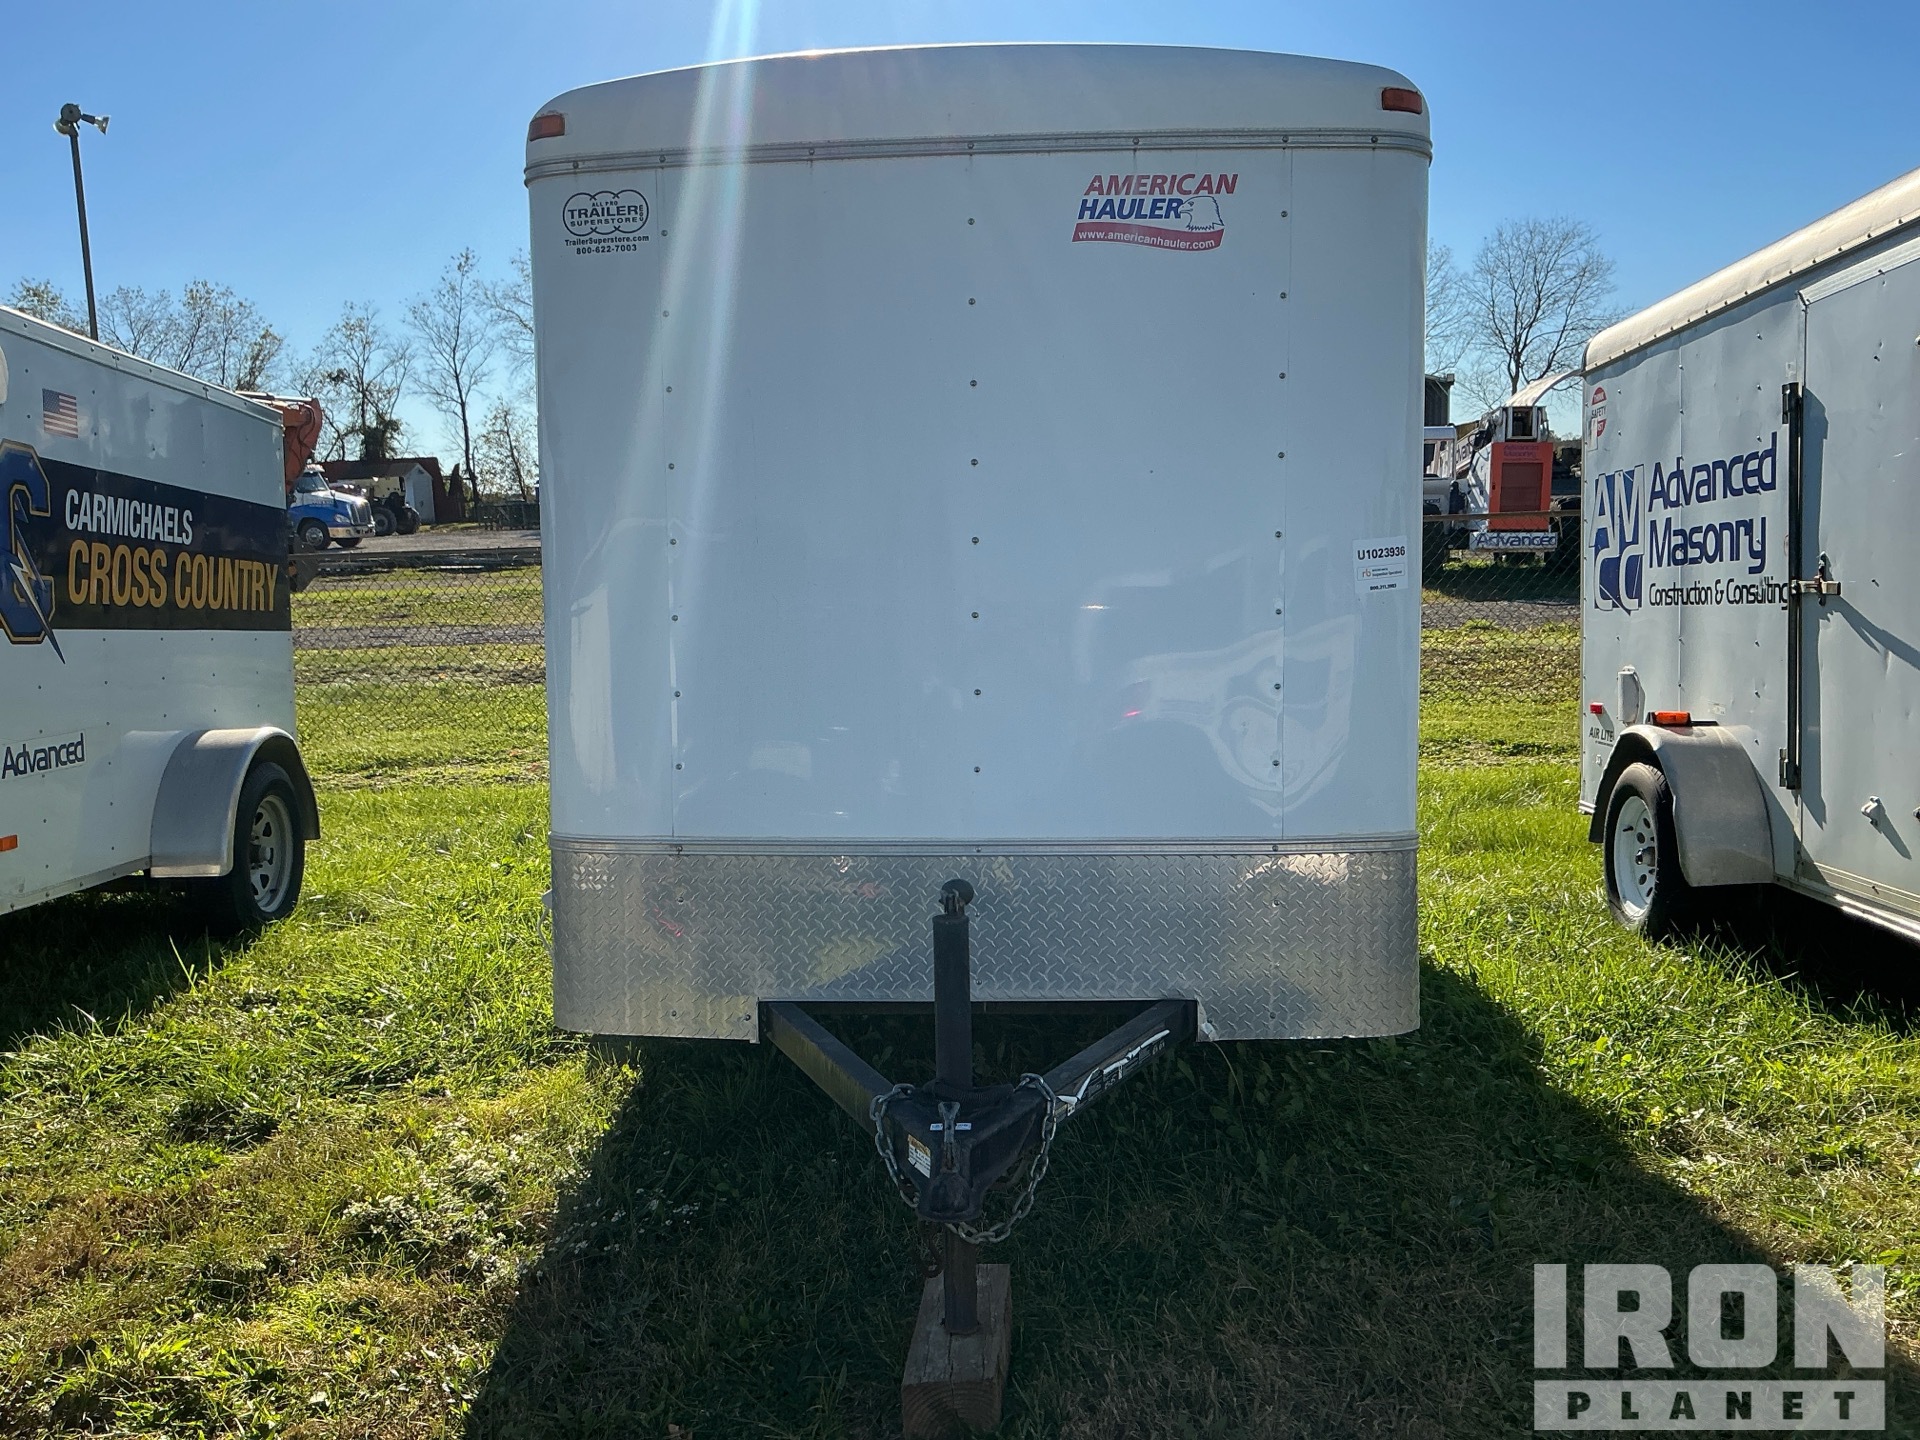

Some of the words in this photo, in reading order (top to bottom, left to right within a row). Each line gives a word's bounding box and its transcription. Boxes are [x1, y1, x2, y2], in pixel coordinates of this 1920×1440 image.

[1083, 173, 1239, 196] AMERICAN
[568, 205, 638, 219] TRAILER
[1077, 198, 1184, 220] HAULER
[570, 216, 638, 227] SUPERSTORE
[564, 235, 650, 247] TrailerSuperstore.com
[576, 244, 637, 255] 800-622-7003
[1078, 230, 1216, 250] www.americanhauler.com
[1648, 431, 1777, 513] Advanced
[65, 488, 193, 546] CARMICHAELS
[1476, 533, 1557, 548] Advanced
[1649, 516, 1767, 575] Masonry
[1357, 545, 1406, 561] U1023936
[68, 539, 168, 608] CROSS
[174, 551, 279, 611] COUNTRY
[1649, 580, 1713, 607] Construction
[1715, 578, 1724, 605] &
[1588, 726, 1600, 739] AIR
[1, 732, 85, 779] Advanced
